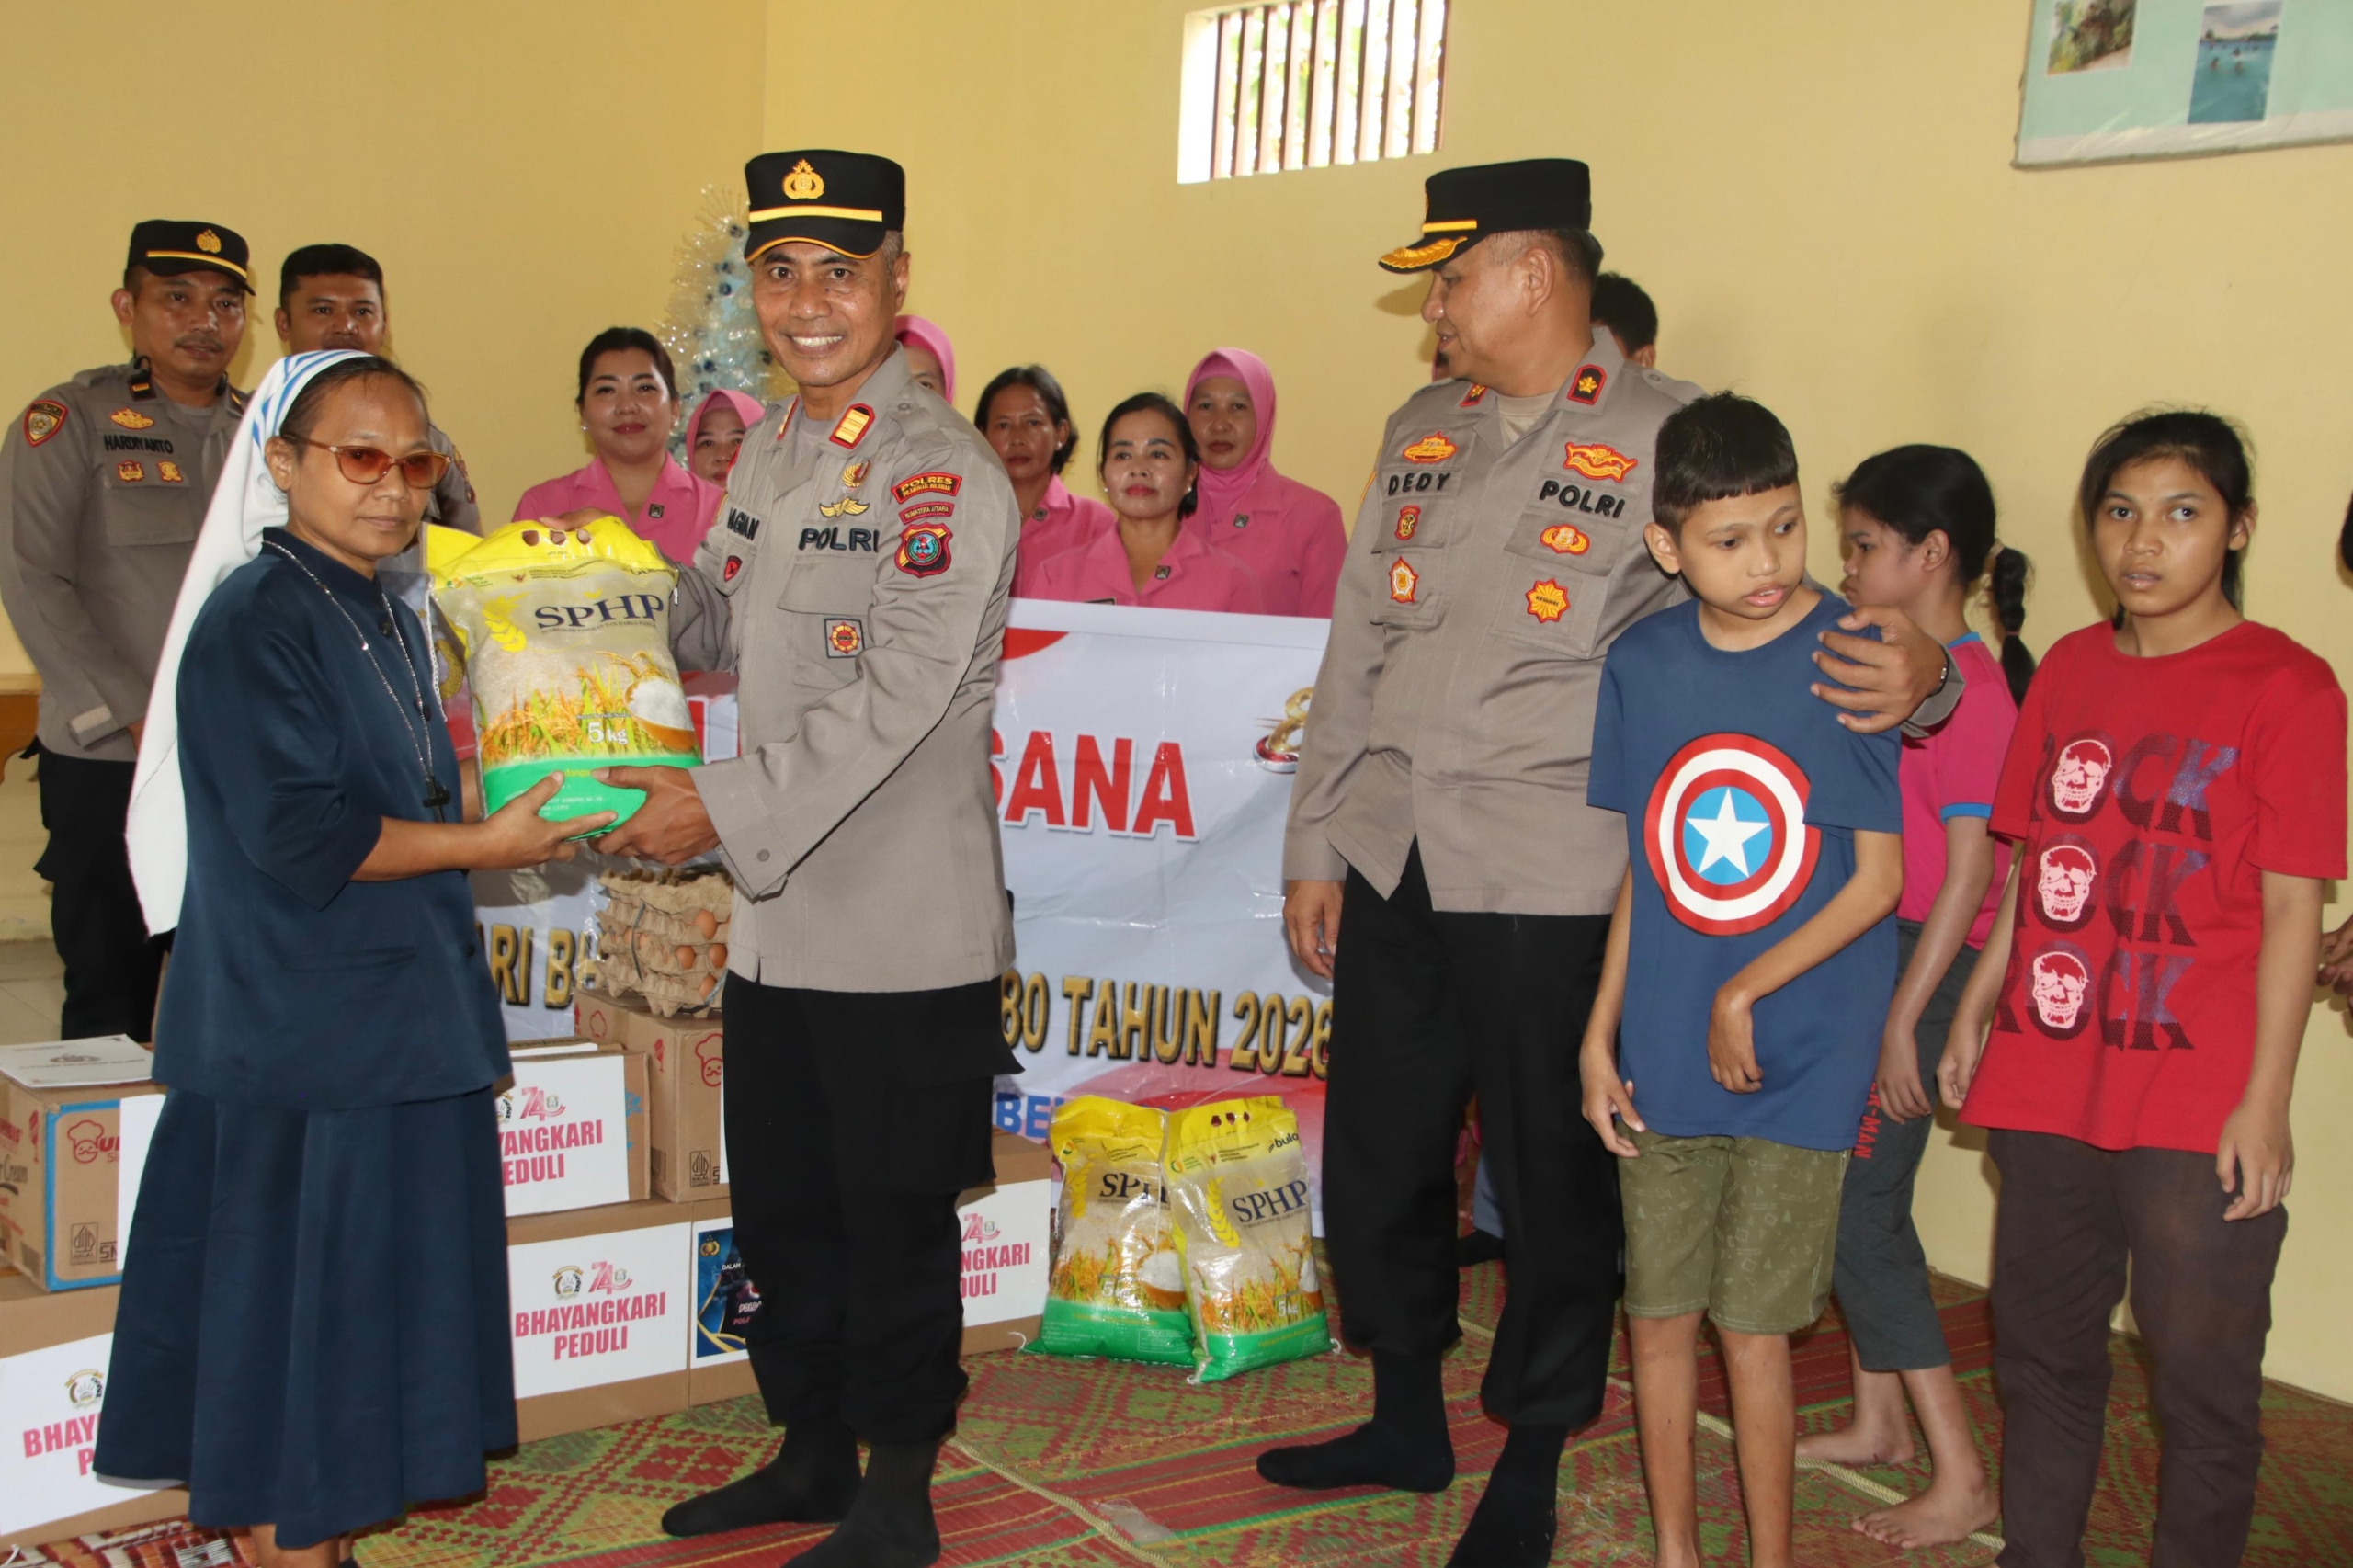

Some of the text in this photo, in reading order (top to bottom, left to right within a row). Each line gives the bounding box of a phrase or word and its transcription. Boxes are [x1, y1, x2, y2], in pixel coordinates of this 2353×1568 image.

[104, 435, 174, 454] HARDIYANTO
[901, 476, 953, 492] POLRES
[1388, 472, 1451, 496] DEDY
[1539, 480, 1626, 518] POLRI
[904, 505, 949, 519] SUMATERA UTARA
[799, 527, 880, 552] POLRI
[534, 594, 664, 629] SPHP
[588, 722, 629, 744] 5 kg
[474, 922, 534, 1006] RI
[1063, 976, 1221, 1068] TAHUN
[1230, 991, 1333, 1079] 2026
[995, 1092, 1064, 1139] BE
[1233, 1180, 1307, 1222] SPHP
[1102, 1281, 1115, 1298] 5
[515, 1291, 666, 1338] BHAYANGKARI
[1278, 1301, 1287, 1317] 5
[554, 1325, 628, 1361] PEDULI
